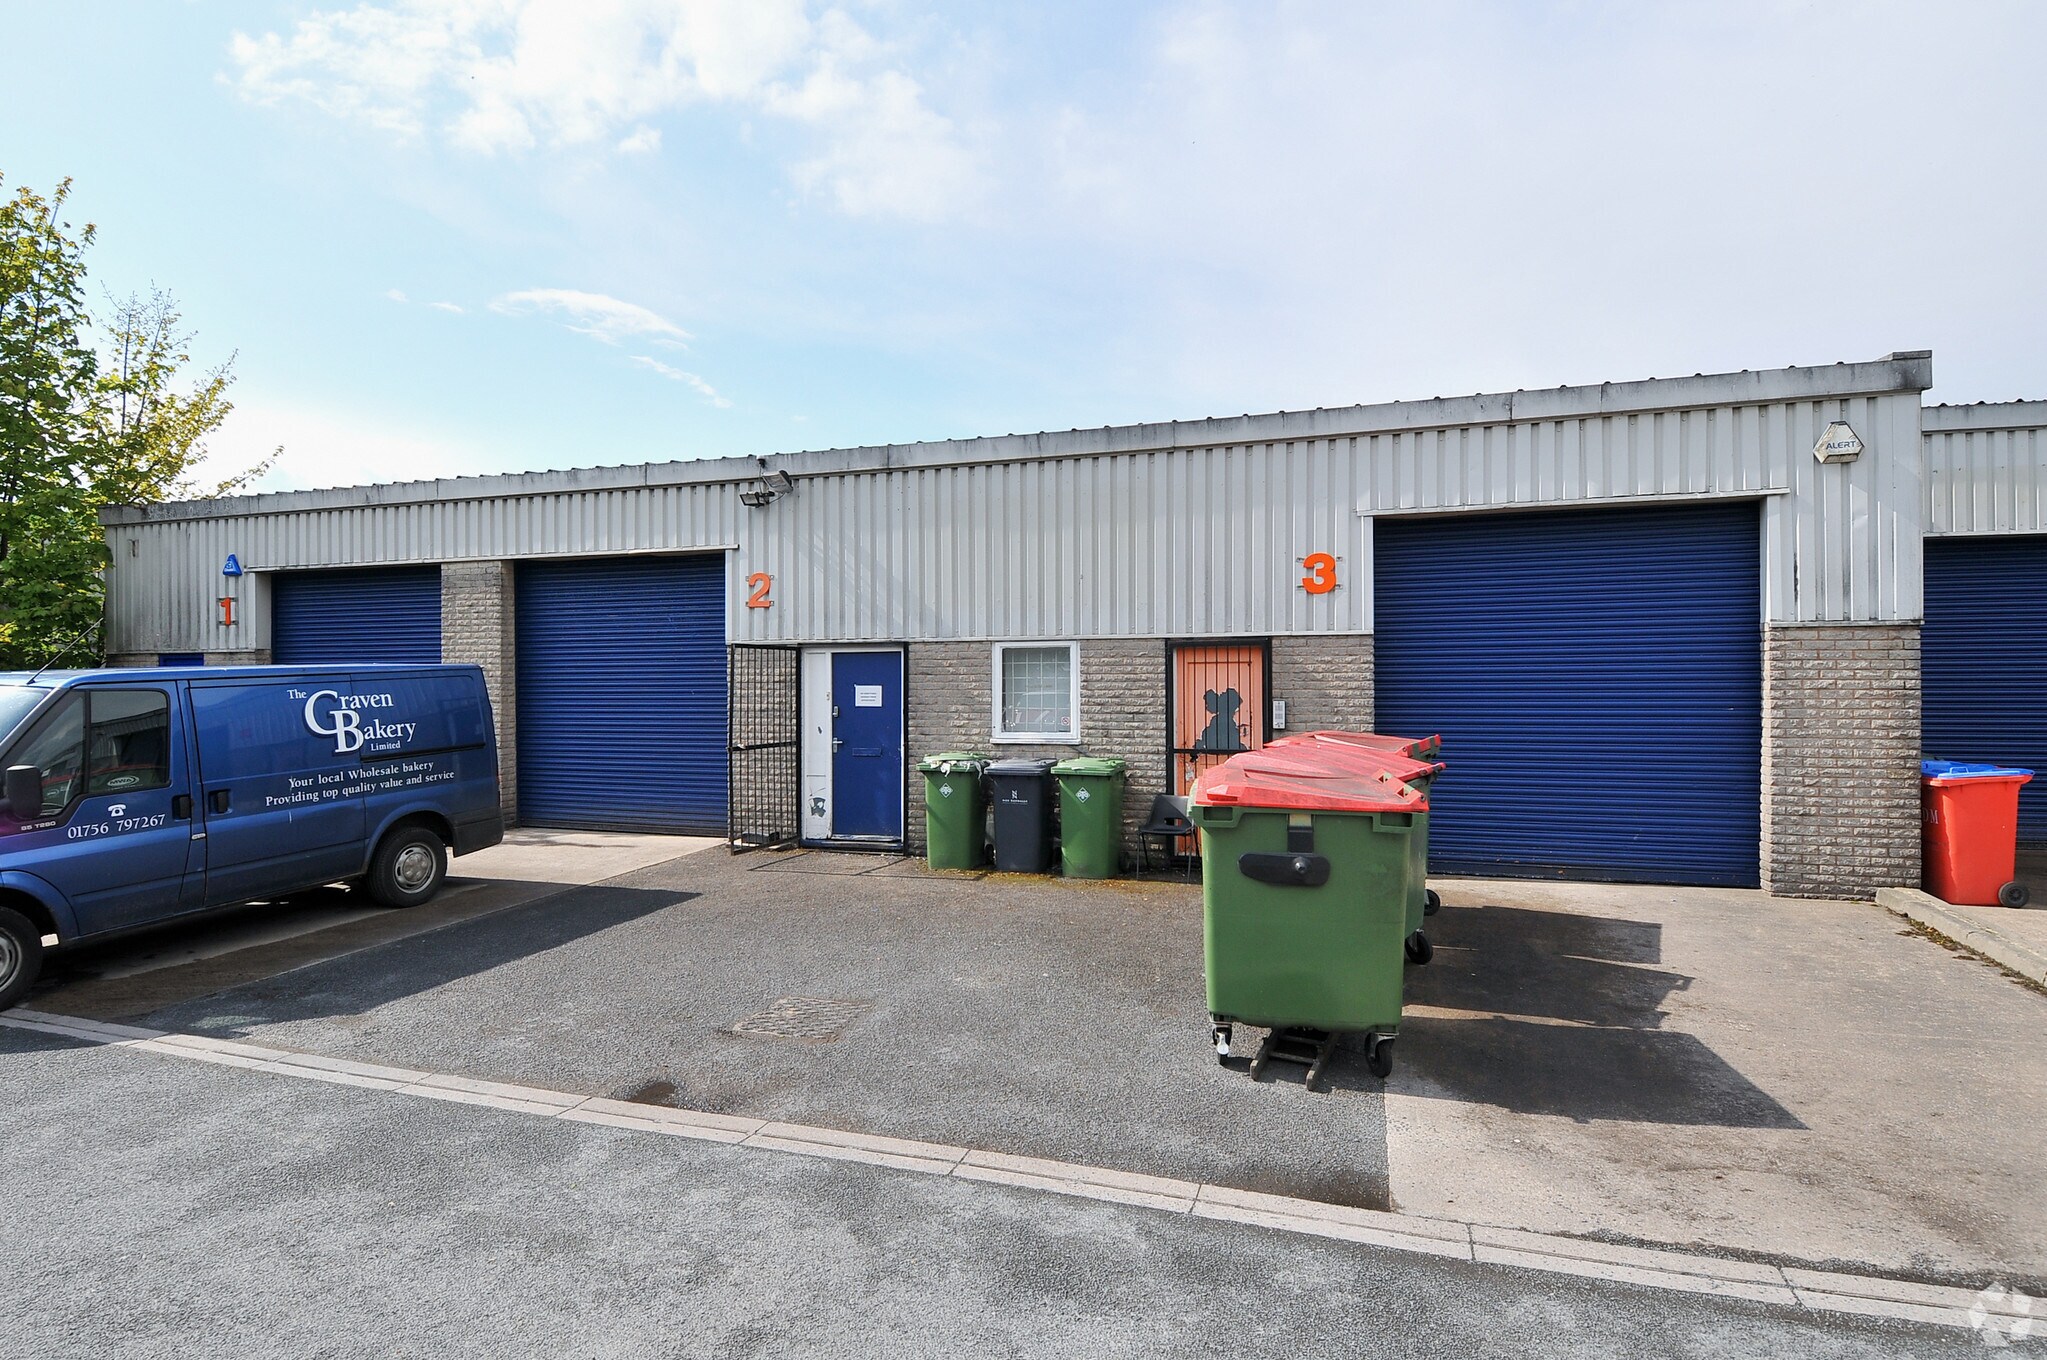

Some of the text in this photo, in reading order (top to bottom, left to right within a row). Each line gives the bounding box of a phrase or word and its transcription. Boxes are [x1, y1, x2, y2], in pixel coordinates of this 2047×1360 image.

[1826, 440, 1856, 450] ALERT
[1302, 552, 1337, 595] 3
[748, 572, 771, 608] 2
[220, 597, 231, 625] 1
[287, 689, 394, 735] The Craven
[329, 709, 416, 752] Bakery
[370, 740, 401, 751] Limited
[265, 771, 455, 807] Providing top quality value and service
[288, 762, 434, 788] Your local Wholesale bakery
[67, 814, 166, 839] 01756 797267
